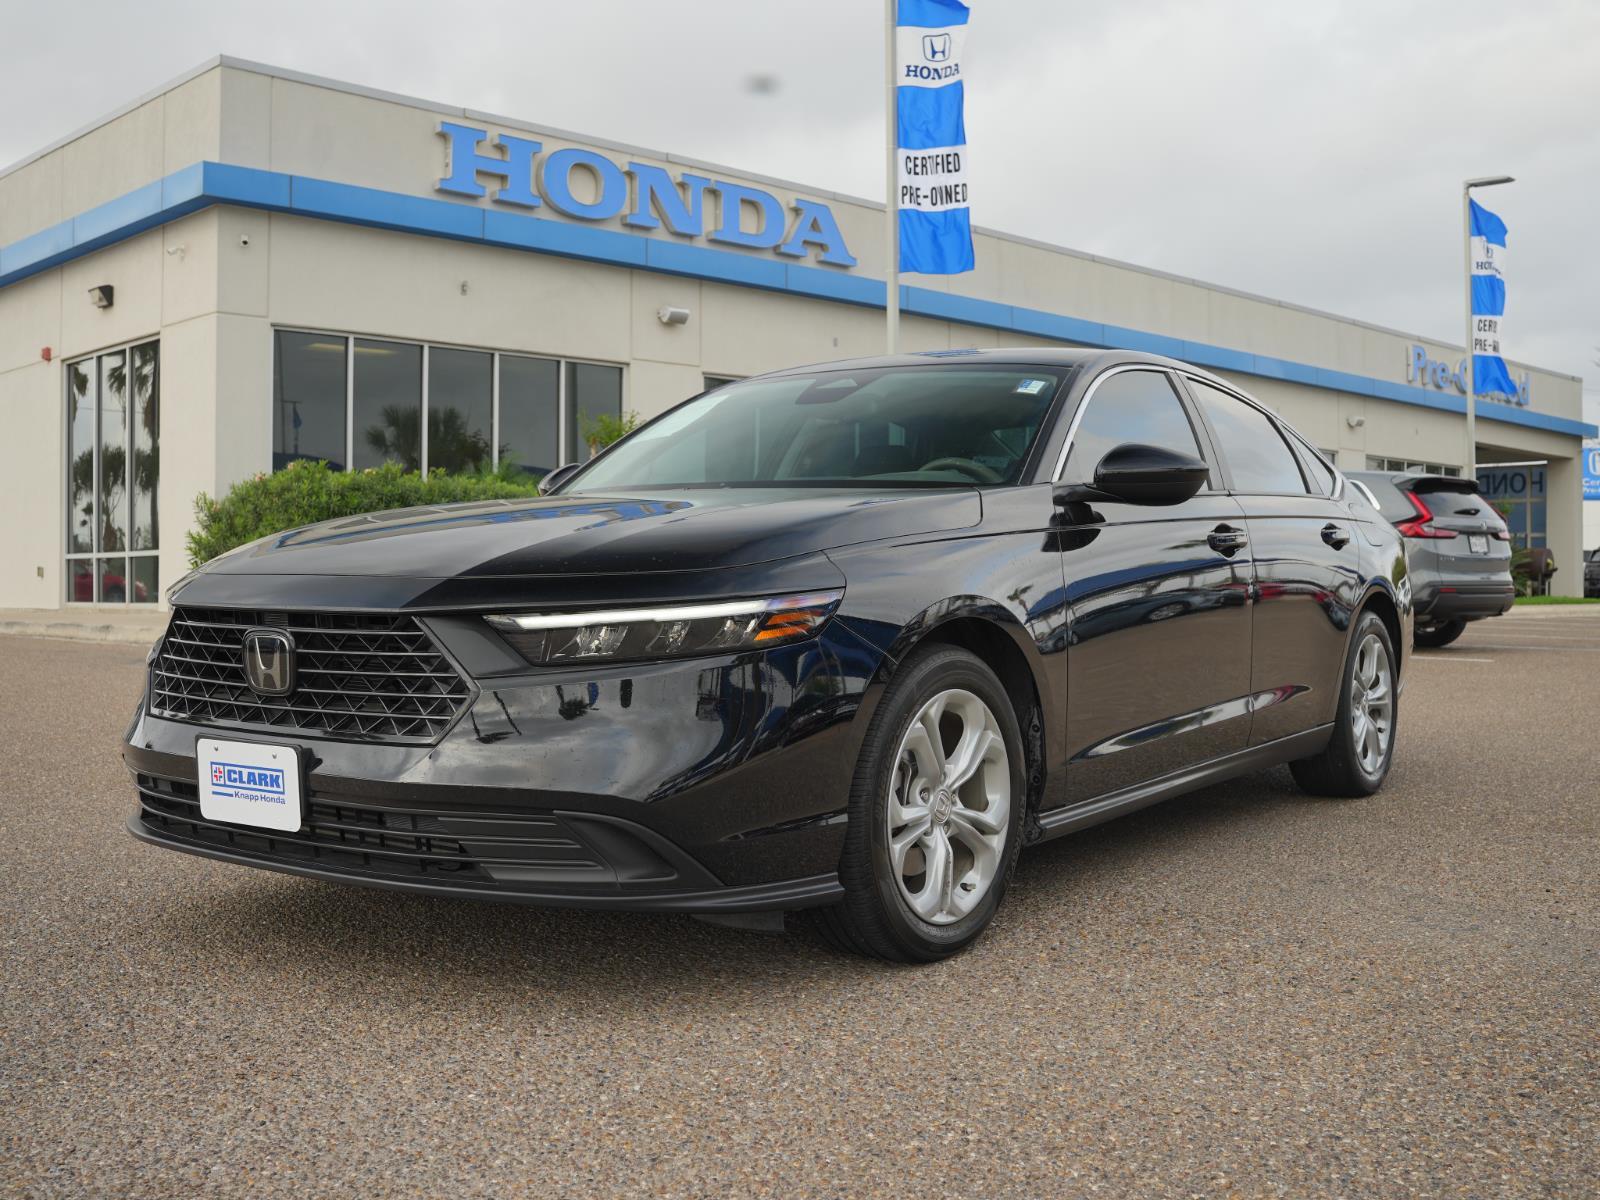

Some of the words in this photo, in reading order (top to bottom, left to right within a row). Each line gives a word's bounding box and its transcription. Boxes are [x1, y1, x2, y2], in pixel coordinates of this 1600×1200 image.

[905, 63, 960, 80] HONDA
[905, 152, 961, 176] CERTIFIED
[435, 121, 857, 268] HONDA
[901, 183, 968, 207] PRE-OWNED
[226, 768, 281, 789] CLARK
[234, 790, 259, 803] Knapp
[260, 794, 286, 805] Honda
